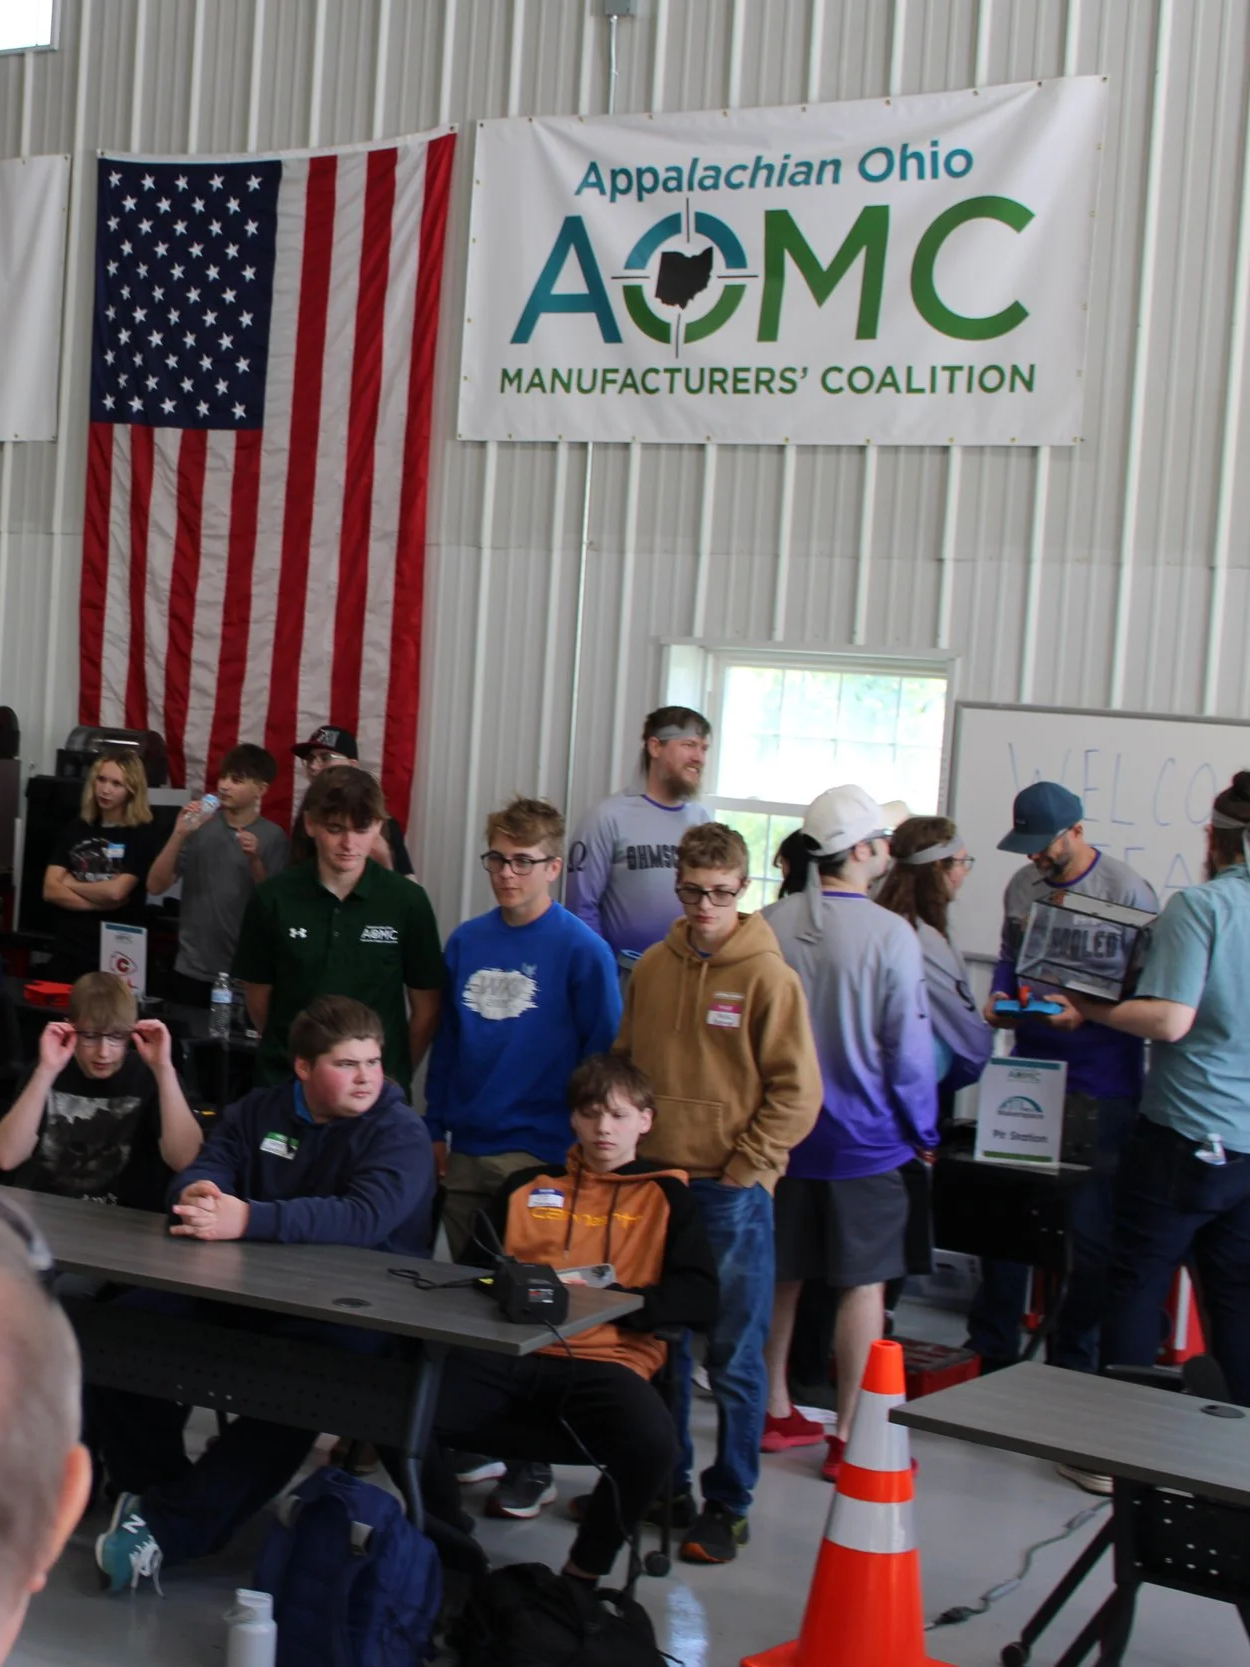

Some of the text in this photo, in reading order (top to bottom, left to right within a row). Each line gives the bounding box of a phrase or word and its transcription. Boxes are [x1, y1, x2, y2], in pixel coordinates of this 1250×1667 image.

[574, 140, 974, 203] Appalachian Ohio
[509, 195, 1036, 345] AOMC
[499, 364, 1036, 396] MANUFACTURERS' COALITION
